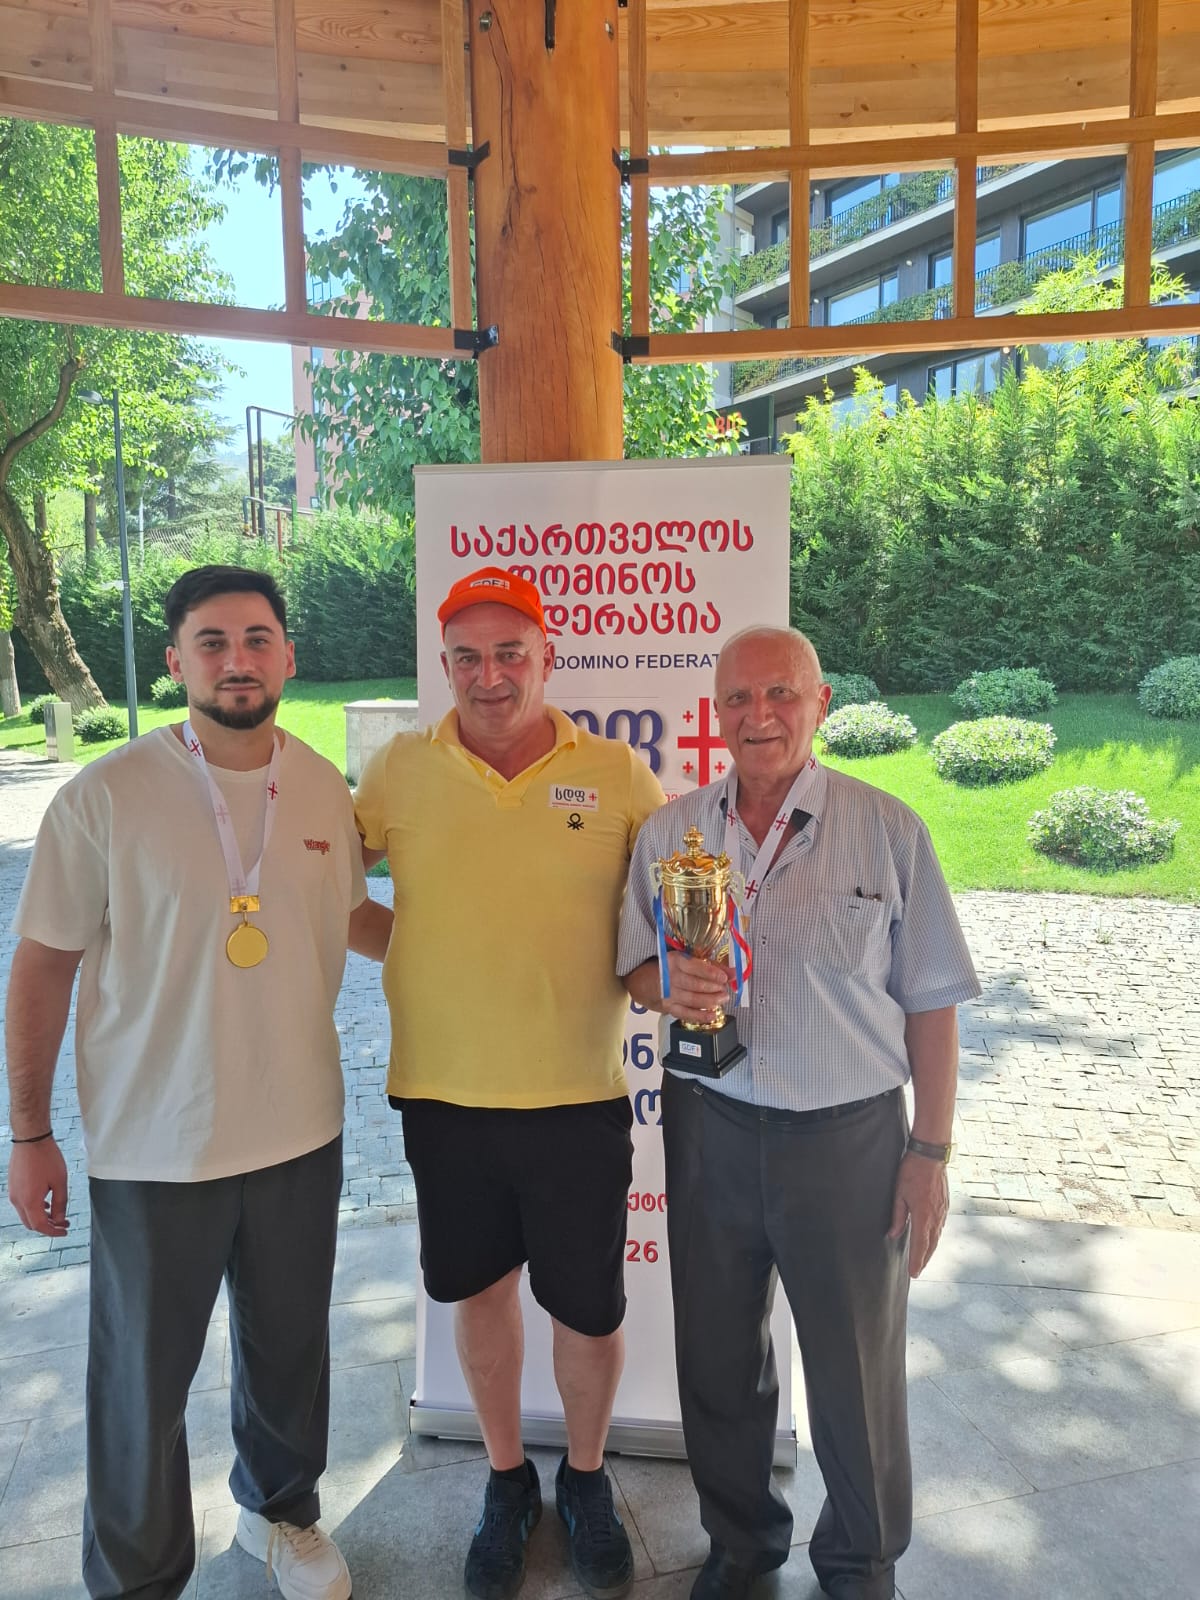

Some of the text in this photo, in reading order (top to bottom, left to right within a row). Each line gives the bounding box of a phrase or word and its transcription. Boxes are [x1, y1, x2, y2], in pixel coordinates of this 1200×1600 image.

[450, 519, 754, 558] საქართველოს
[542, 601, 721, 636] დერაცია
[554, 653, 720, 670] DOMINO FEDERAT
